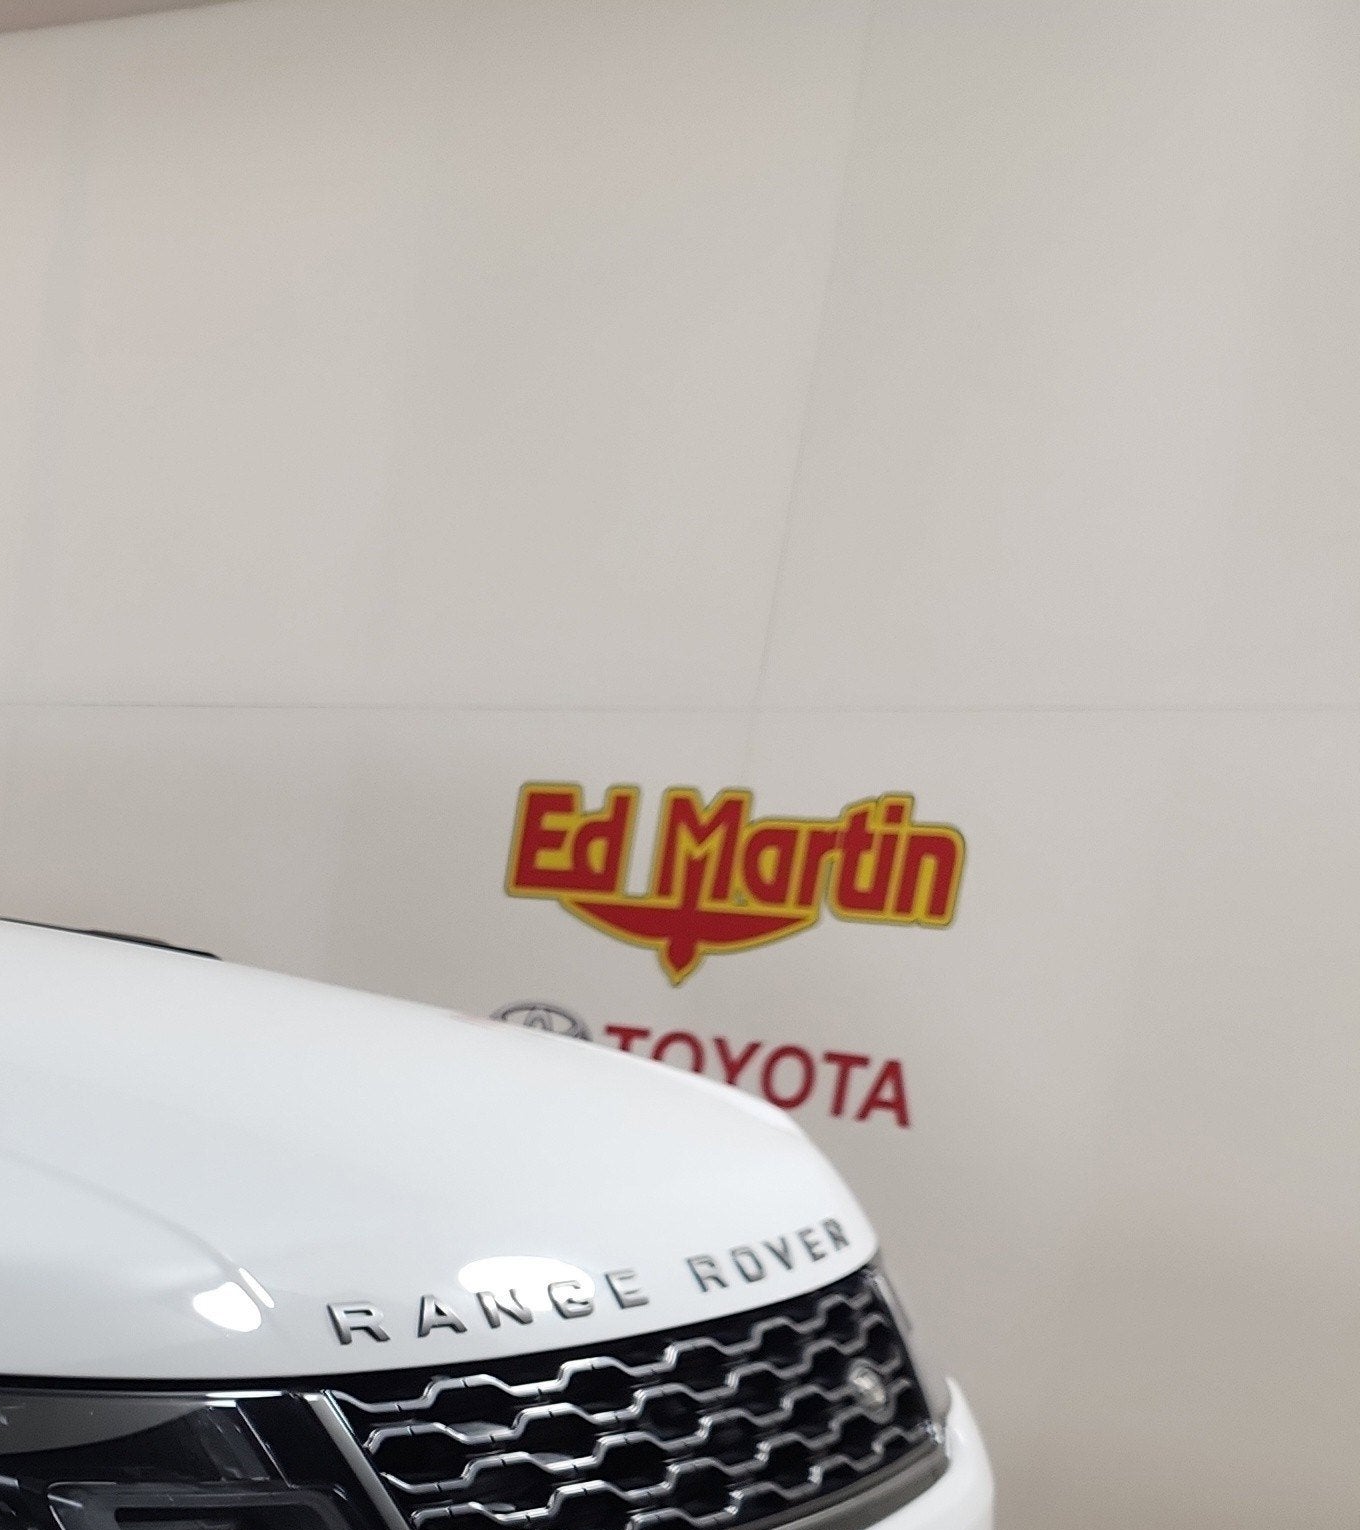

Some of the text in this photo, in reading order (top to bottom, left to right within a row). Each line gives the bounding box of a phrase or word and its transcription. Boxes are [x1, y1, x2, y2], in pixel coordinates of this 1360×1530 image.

[512, 790, 962, 919] Ed Martin
[326, 1217, 850, 1345] RANGE ROVER
